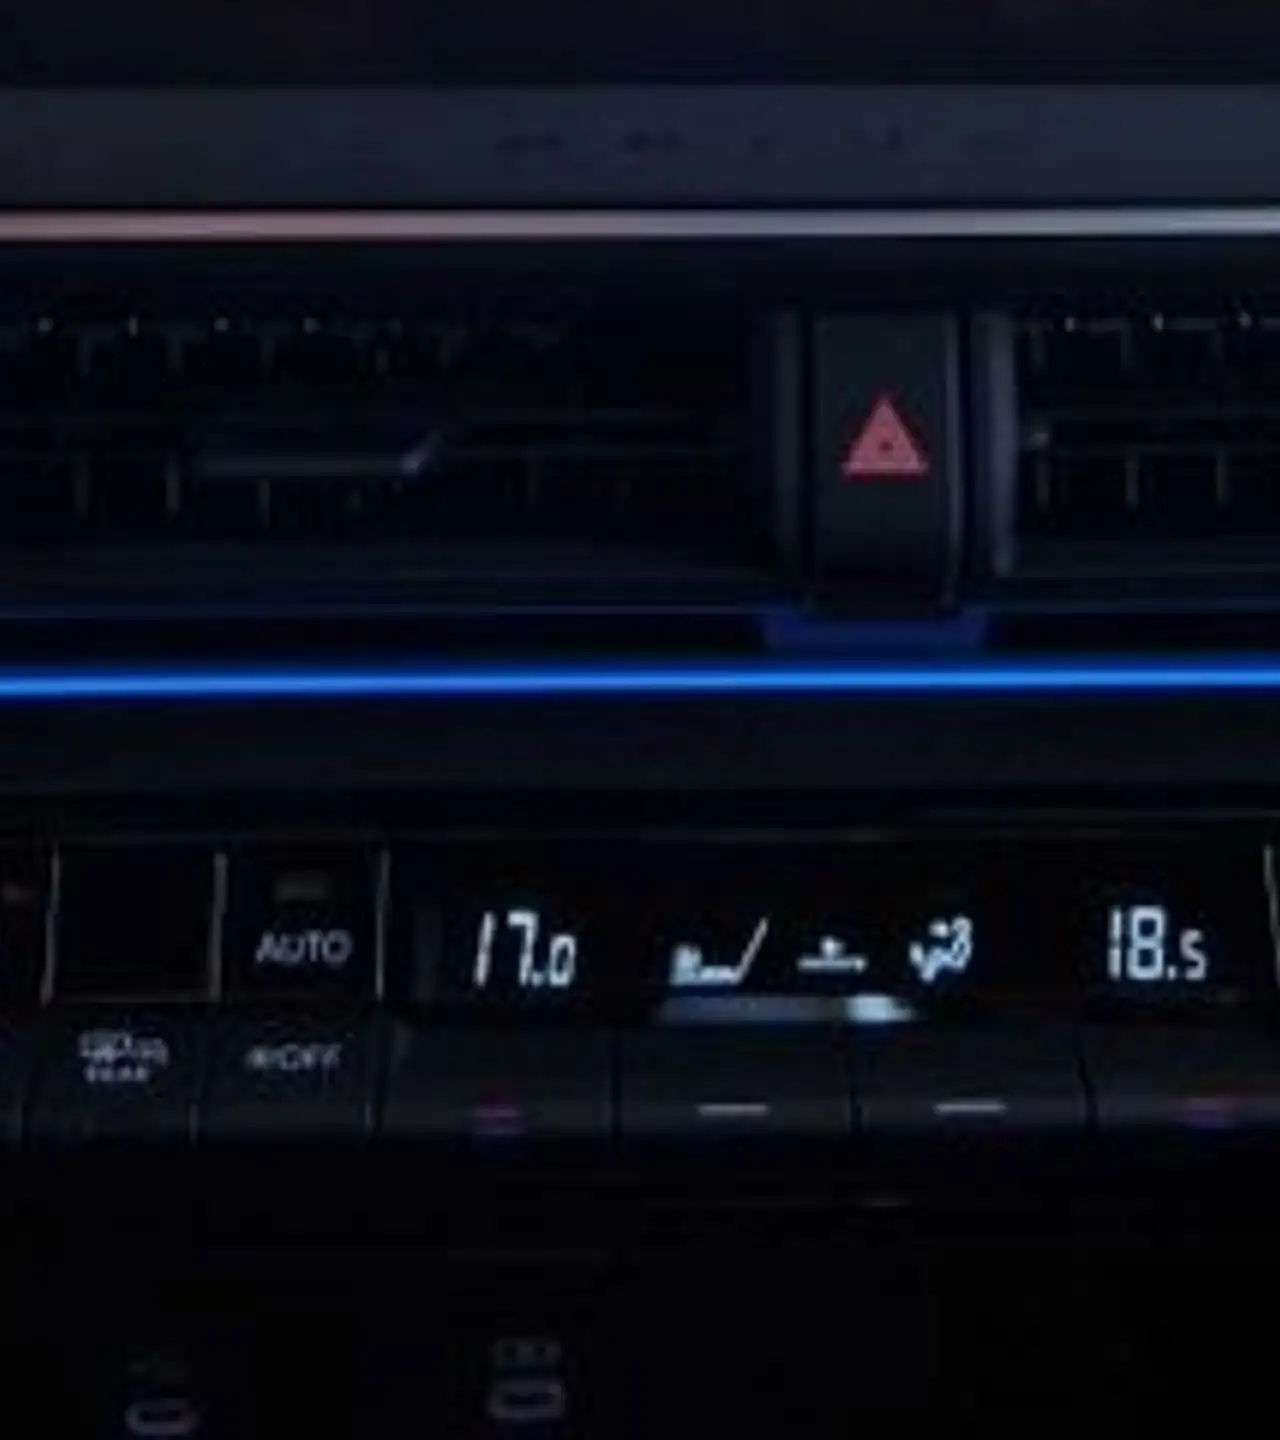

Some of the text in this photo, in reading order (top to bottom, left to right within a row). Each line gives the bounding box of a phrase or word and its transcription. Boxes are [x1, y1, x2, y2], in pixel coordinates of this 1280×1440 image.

[255, 928, 354, 965] AUTO
[473, 908, 578, 989] 17.0
[1106, 905, 1208, 981] 18.5
